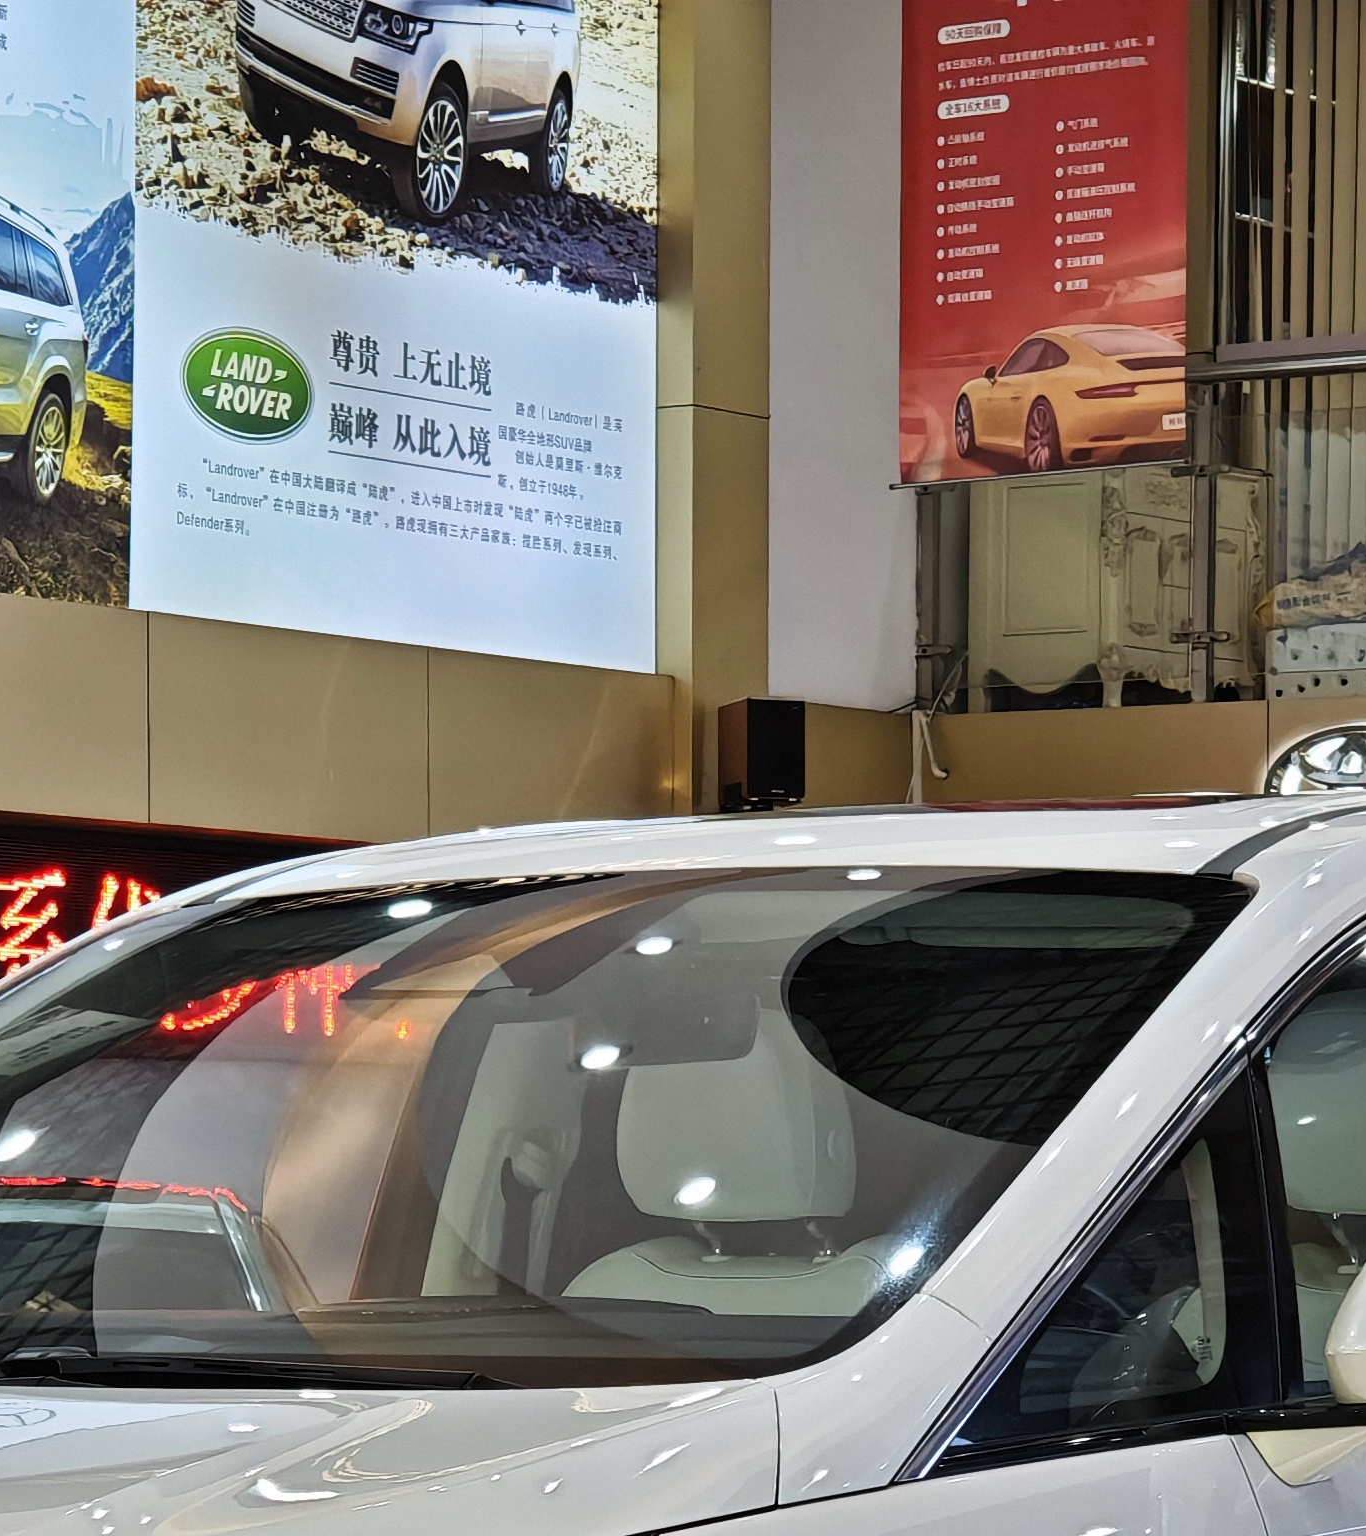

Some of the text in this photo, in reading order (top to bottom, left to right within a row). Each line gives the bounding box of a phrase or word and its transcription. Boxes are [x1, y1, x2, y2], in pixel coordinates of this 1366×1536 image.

[210, 348, 273, 384] LAND
[330, 330, 492, 397] 尊贵 上无止境
[215, 382, 290, 421] ROVER
[328, 402, 492, 467] 巅峰 从此入境
